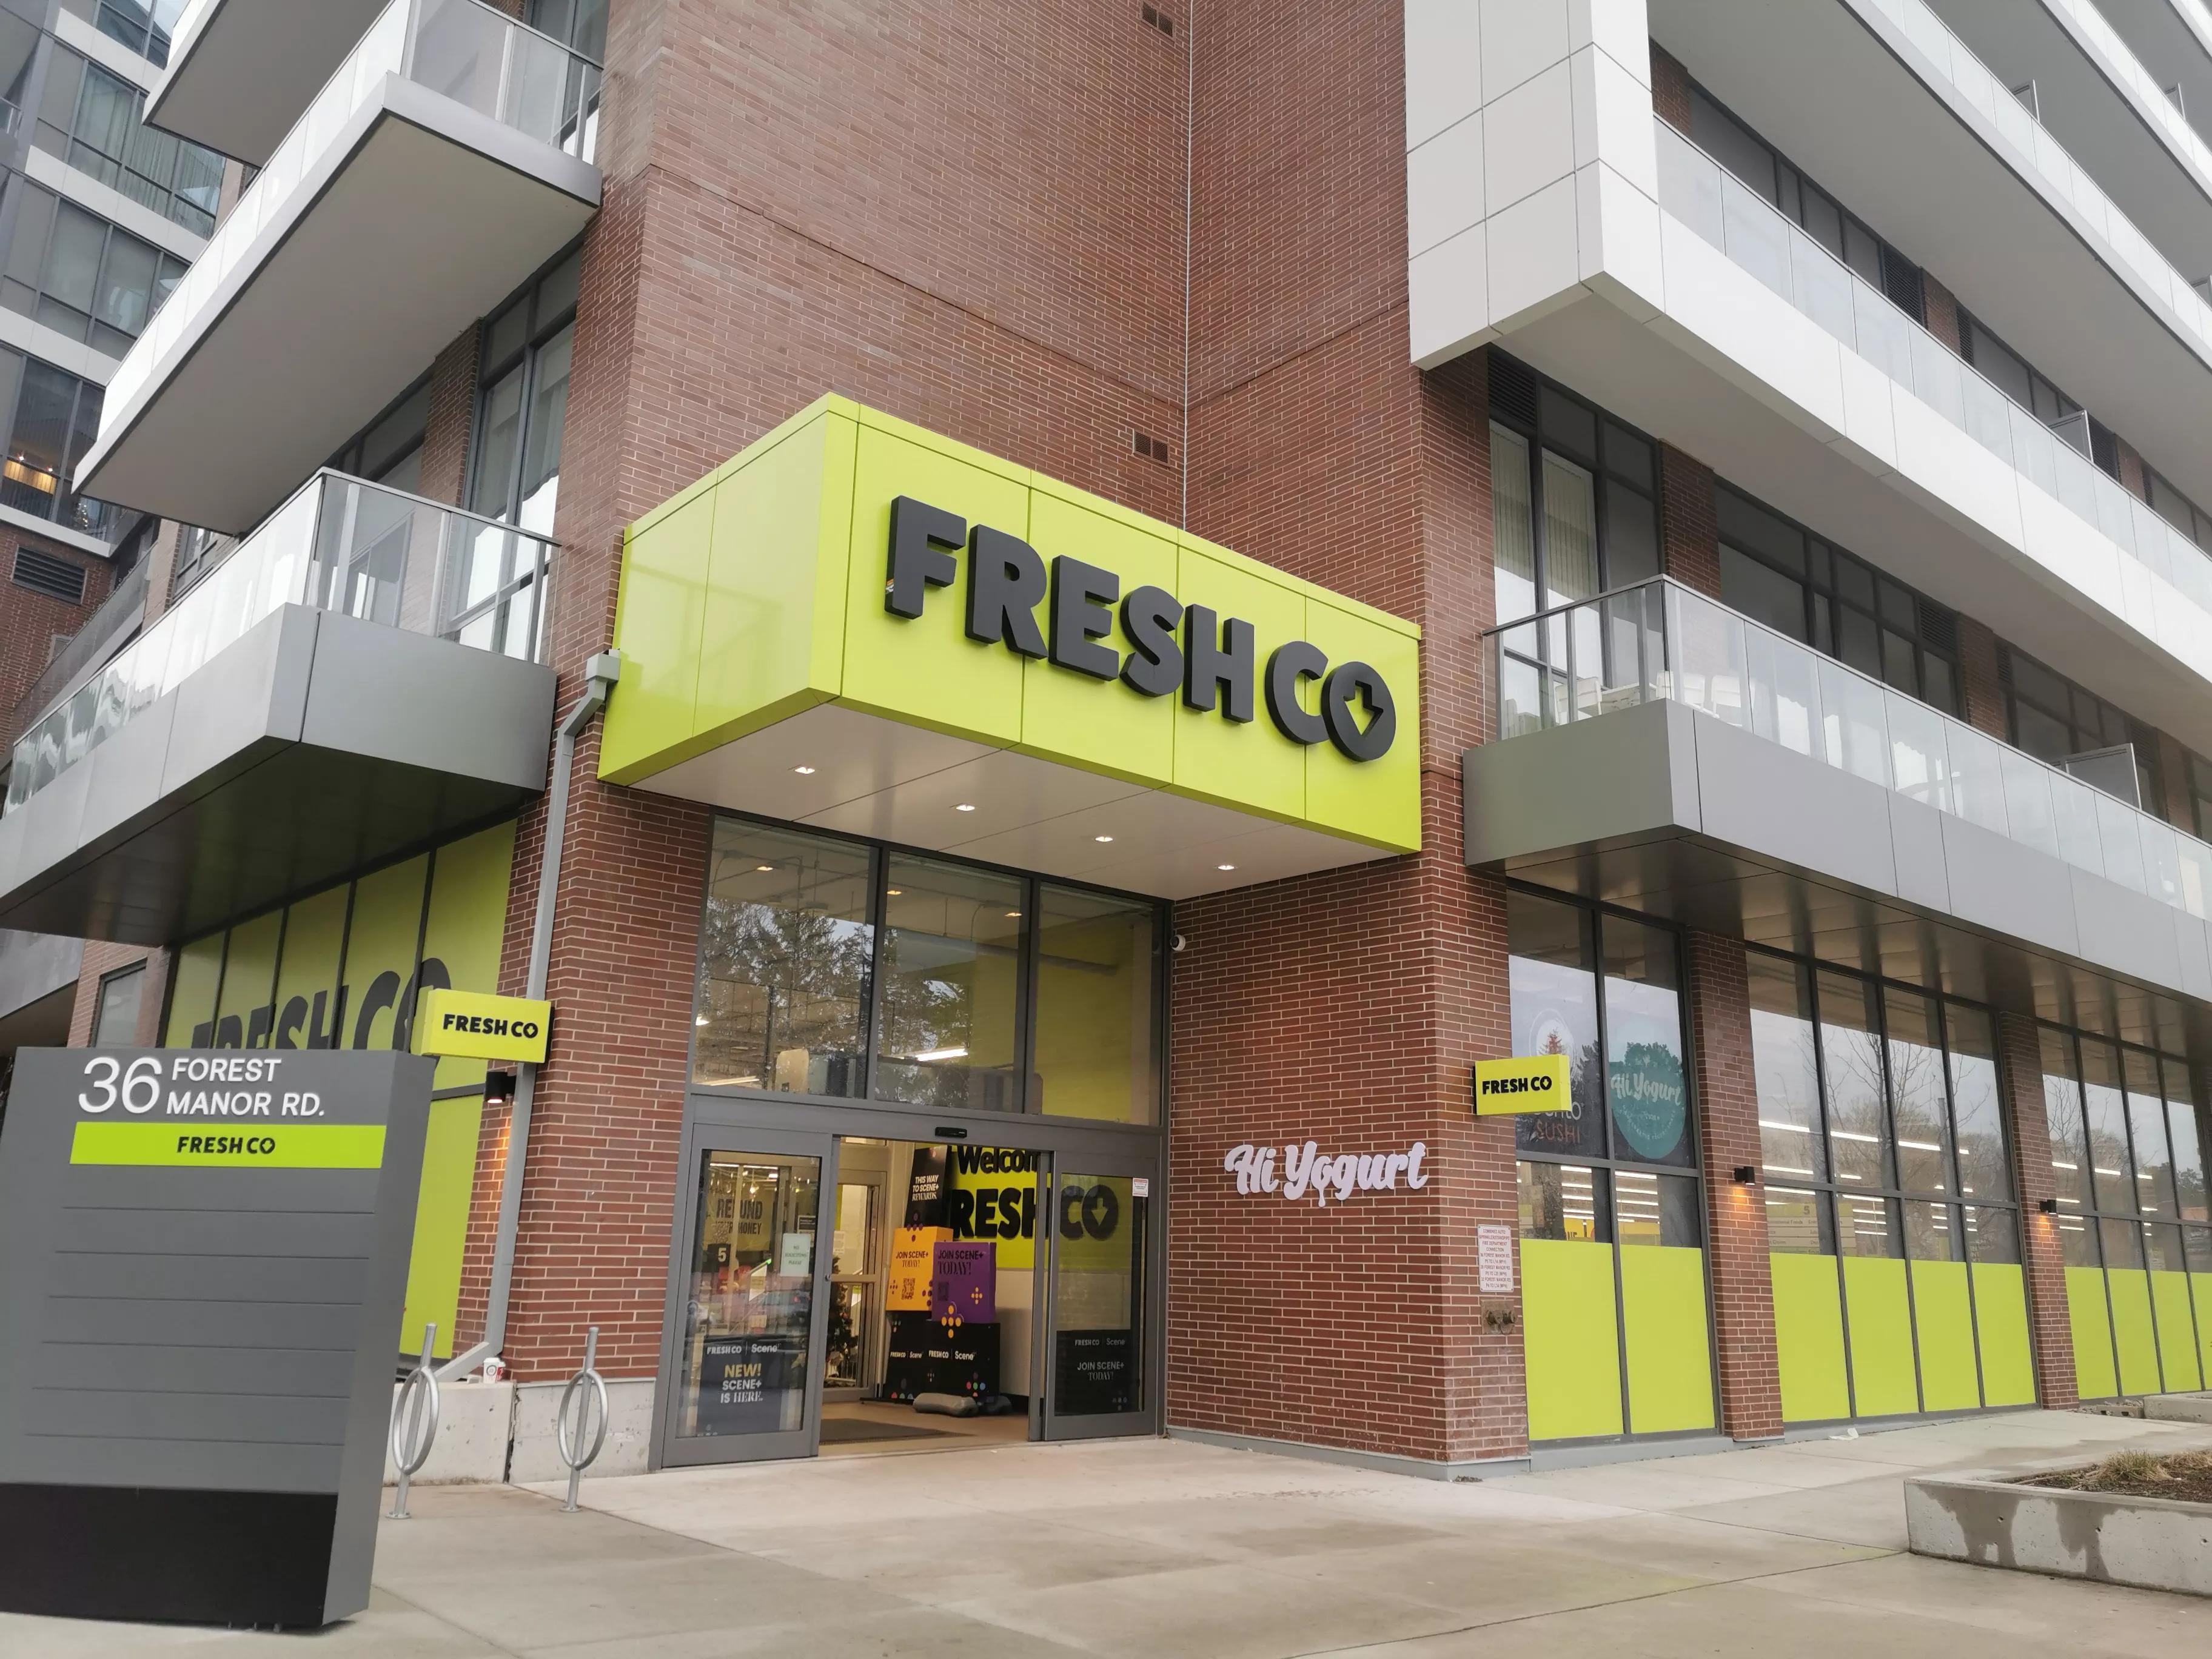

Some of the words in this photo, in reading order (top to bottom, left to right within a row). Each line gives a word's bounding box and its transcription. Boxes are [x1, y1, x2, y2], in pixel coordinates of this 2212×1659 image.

[884, 495, 1255, 724] FRESH
[1264, 641, 1396, 762] CO
[443, 1014, 508, 1035] FRESH
[512, 1022, 538, 1038] CO
[172, 1057, 281, 1082] FOREST
[78, 1056, 163, 1114] 36
[1482, 1078, 1528, 1094] FRESH
[1530, 1076, 1552, 1091] CO
[1610, 1073, 1634, 1100] Hi
[1633, 1071, 1681, 1106] Yogurt
[166, 1091, 272, 1116] MANOR
[281, 1093, 326, 1116] RD.
[1536, 1120, 1581, 1144] SUSHI
[177, 1136, 243, 1154] FRESH
[246, 1138, 275, 1154] CO
[927, 1175, 939, 1183] WAY
[1224, 1144, 1280, 1196] Hi
[1283, 1141, 1429, 1208] Yogurt
[950, 1187, 1050, 1240] RESH
[718, 1247, 726, 1262] 5
[938, 1250, 954, 1259] JOIN
[725, 1363, 762, 1378] NEW!
[1078, 1362, 1095, 1370] JOIN
[720, 1393, 731, 1404] IS
